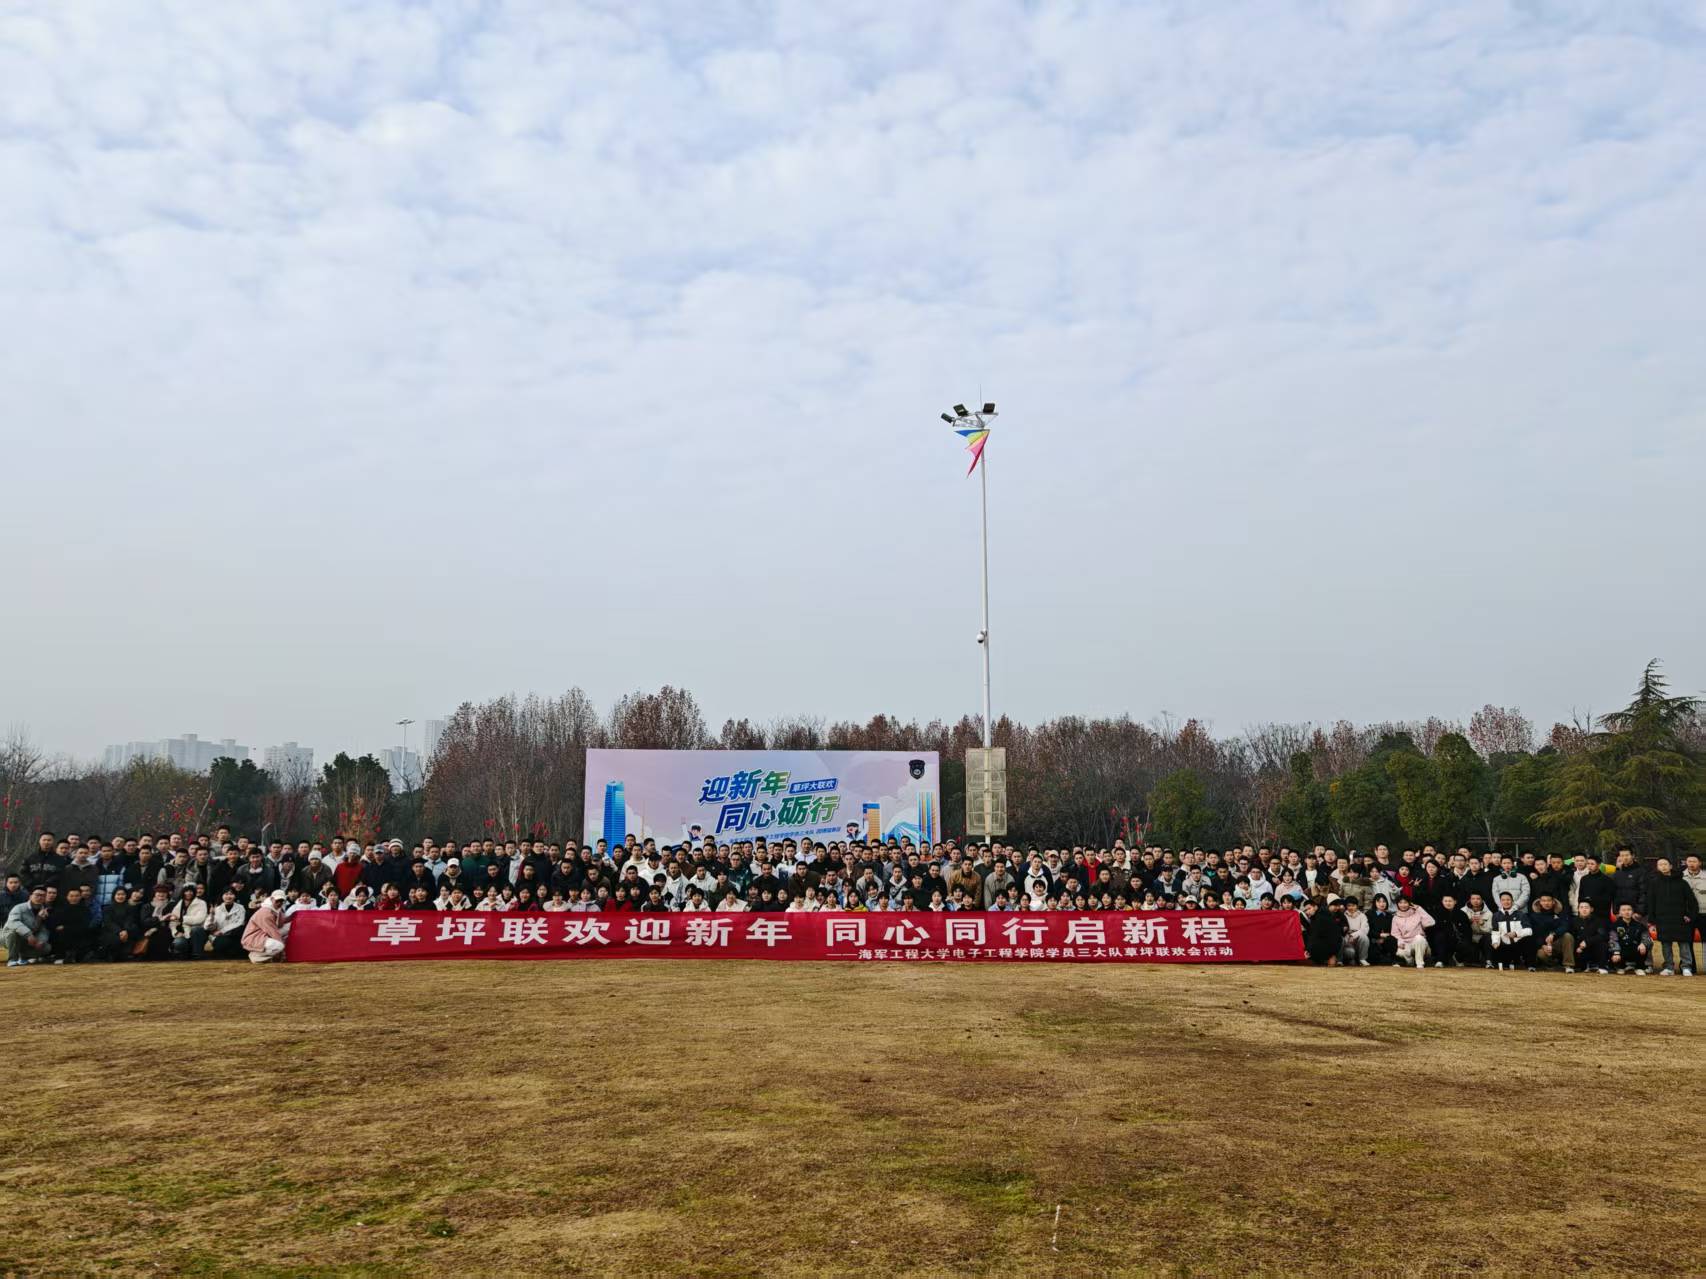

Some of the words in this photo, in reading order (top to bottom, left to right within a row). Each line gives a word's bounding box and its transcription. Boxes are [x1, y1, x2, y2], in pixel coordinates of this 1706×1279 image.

[699, 769, 789, 803] 迎新年
[715, 795, 839, 834] 同心砺行
[369, 917, 793, 947] 草坪联欢迎新年
[826, 917, 1231, 947] 同心同行启新程
